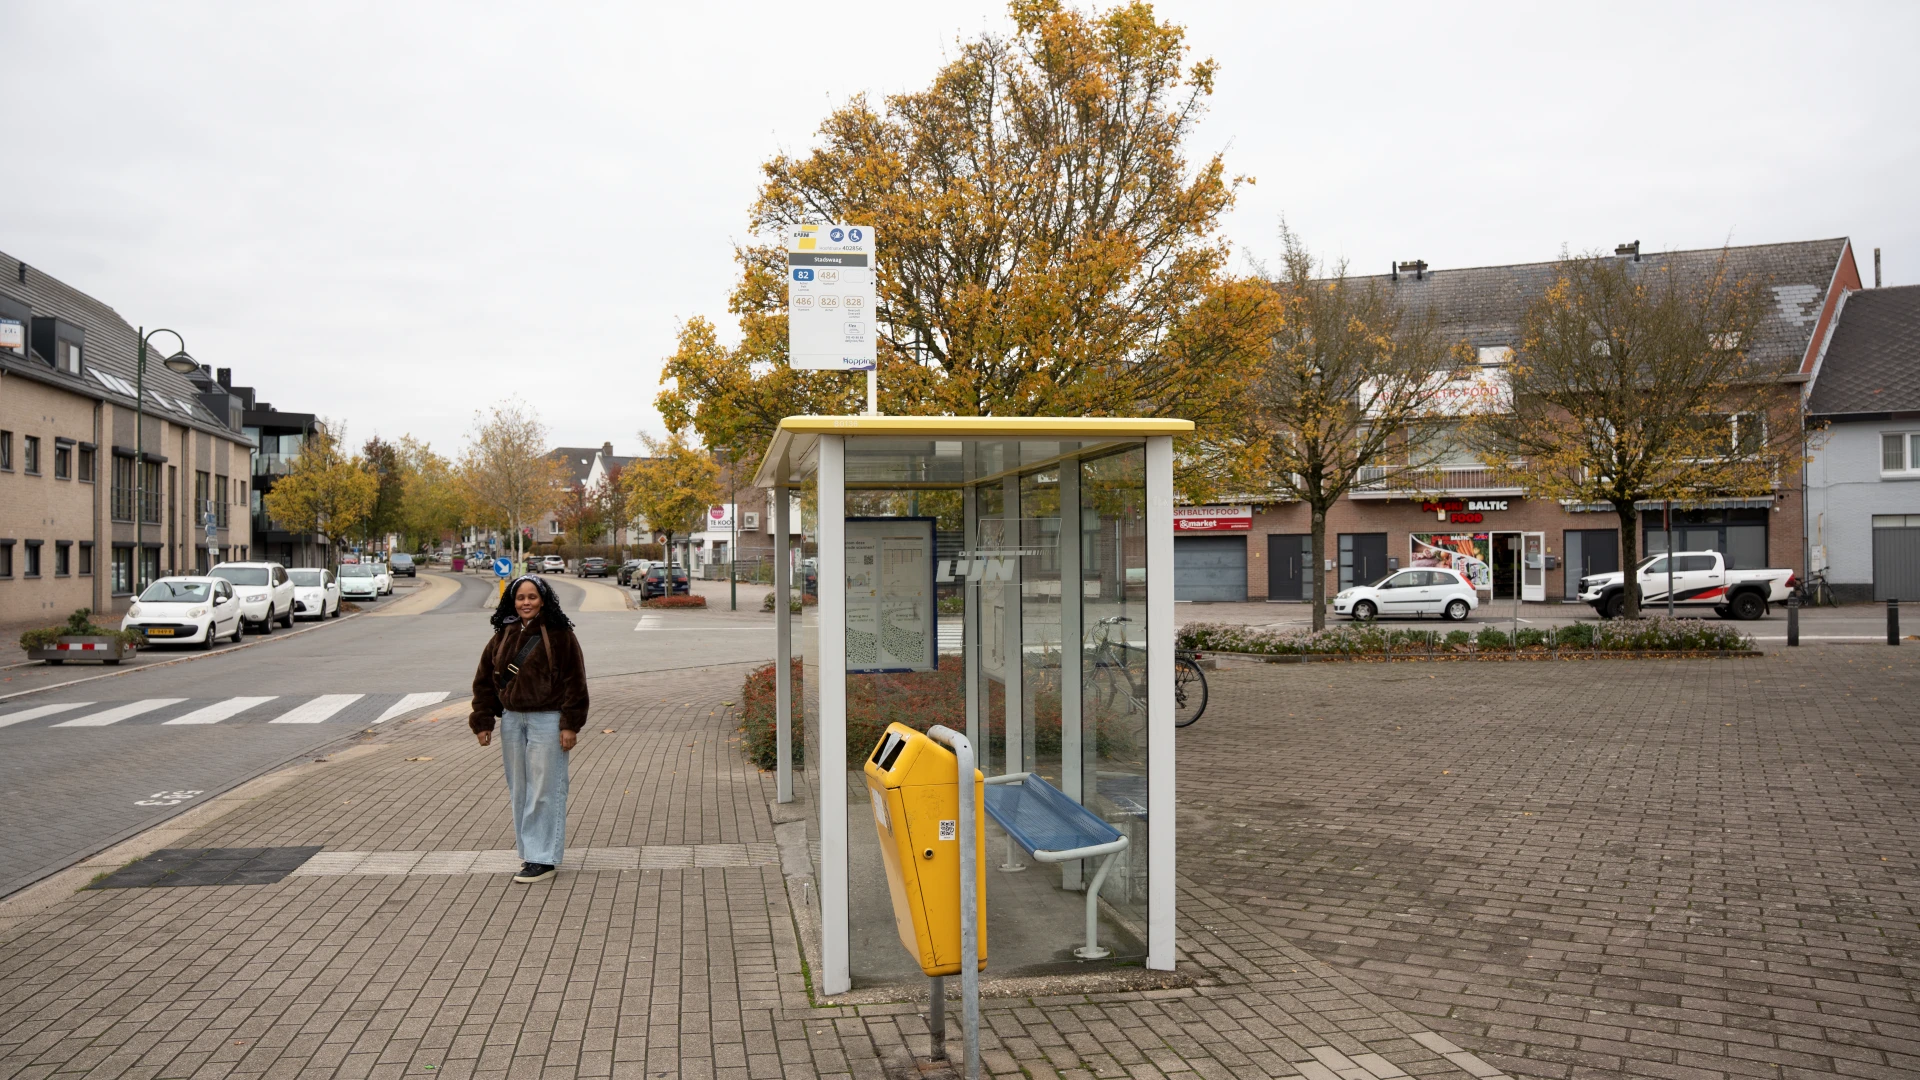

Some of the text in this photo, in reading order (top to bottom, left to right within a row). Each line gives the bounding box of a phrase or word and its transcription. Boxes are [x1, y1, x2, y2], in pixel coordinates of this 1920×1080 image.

[798, 272, 809, 280] 82
[796, 298, 812, 306] 486
[820, 298, 836, 306] 826
[1463, 386, 1499, 397] FOOD
[1468, 500, 1508, 511] BALTIC
[1450, 513, 1483, 523] FOOD
[936, 560, 1016, 582] LIJN
